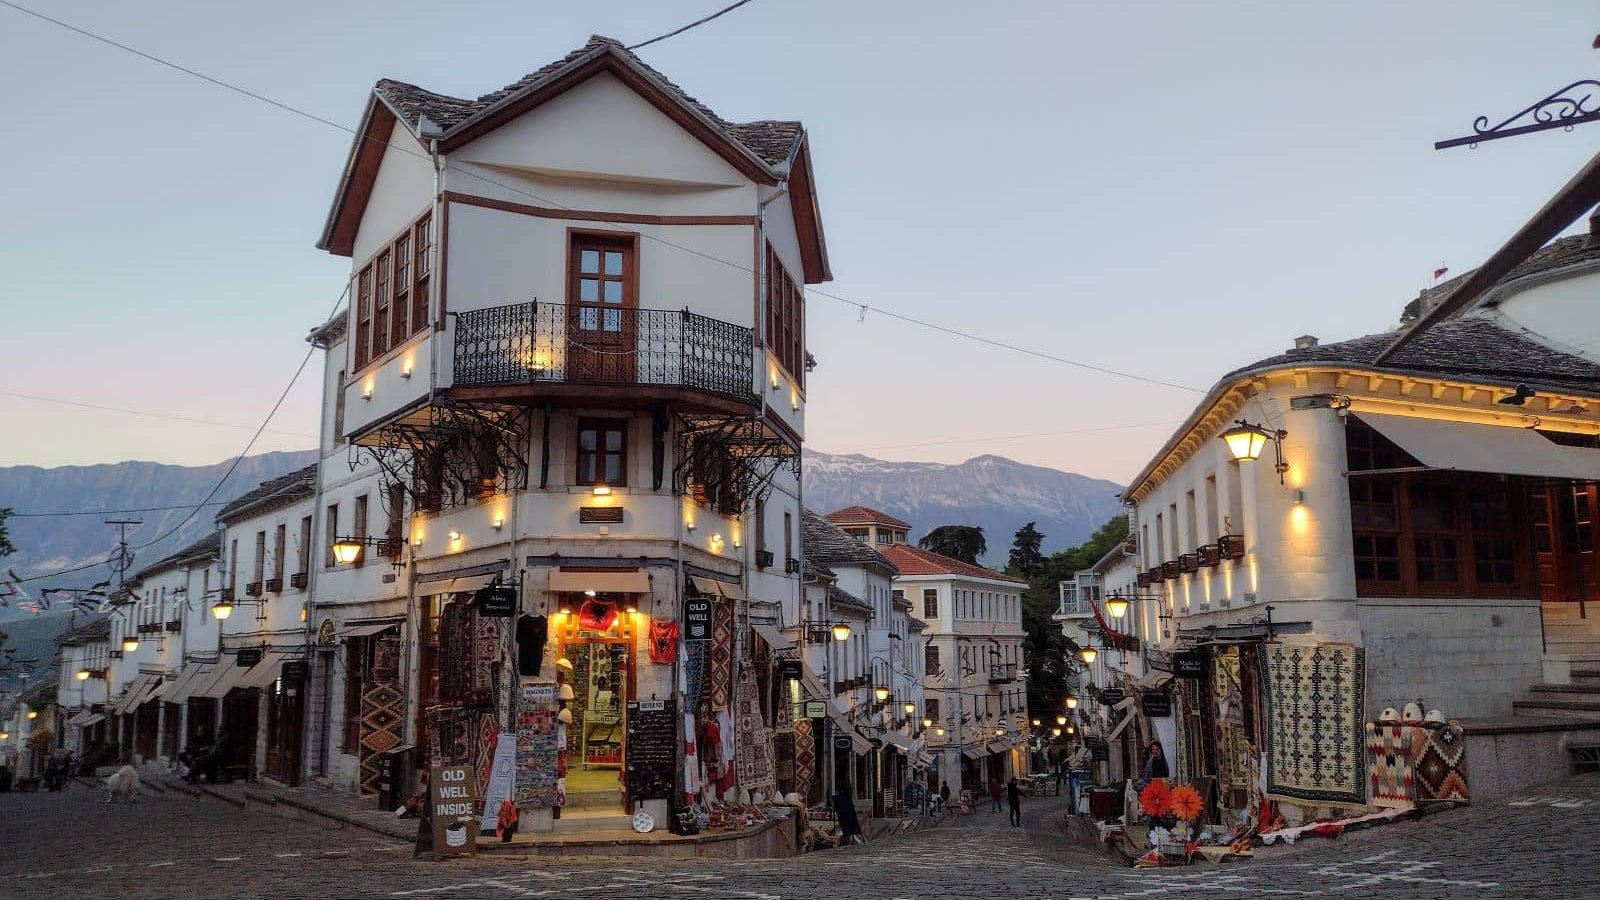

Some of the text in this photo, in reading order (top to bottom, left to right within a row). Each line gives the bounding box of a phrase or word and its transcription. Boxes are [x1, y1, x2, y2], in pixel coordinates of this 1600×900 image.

[689, 603, 708, 611] OLD
[688, 613, 708, 621] WELL
[525, 688, 552, 696] MAGNETS
[442, 769, 465, 782] OLD
[439, 786, 469, 799] WELL
[436, 803, 473, 816] INSIDE
